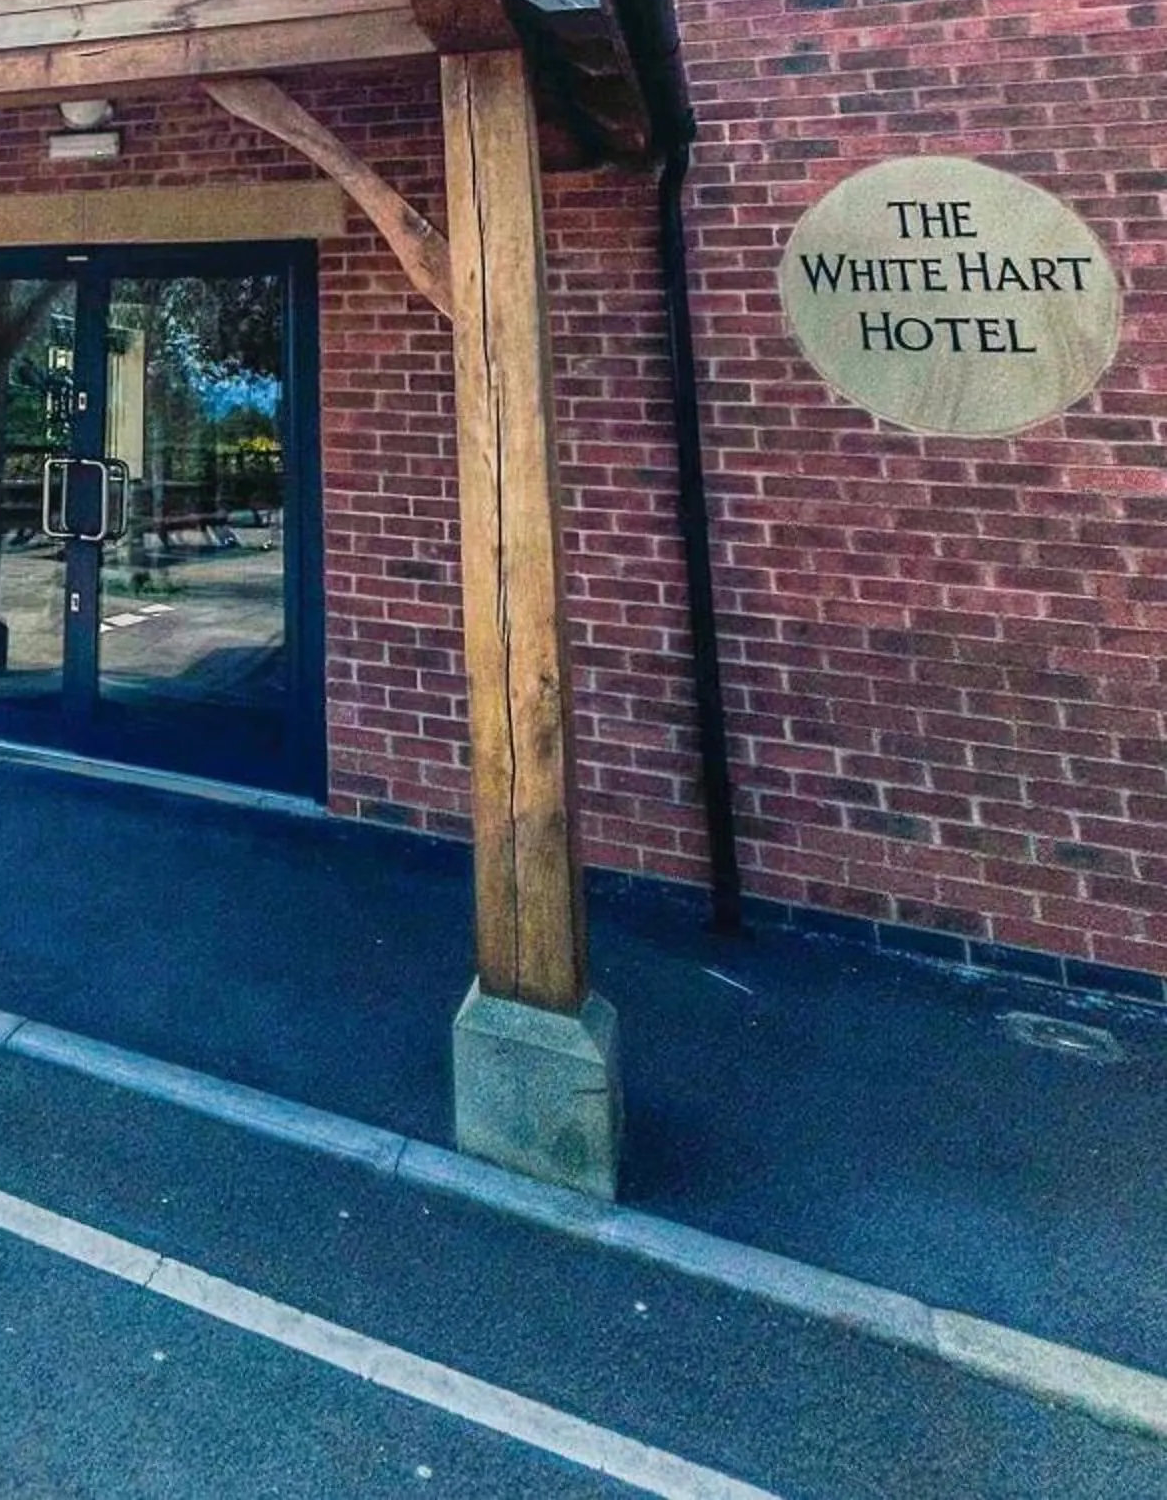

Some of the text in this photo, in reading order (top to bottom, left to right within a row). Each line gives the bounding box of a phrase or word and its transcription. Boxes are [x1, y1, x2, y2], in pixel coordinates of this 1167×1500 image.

[887, 201, 977, 238] THE
[799, 252, 1091, 294] WHITE HART
[858, 311, 1036, 353] HOTEL
